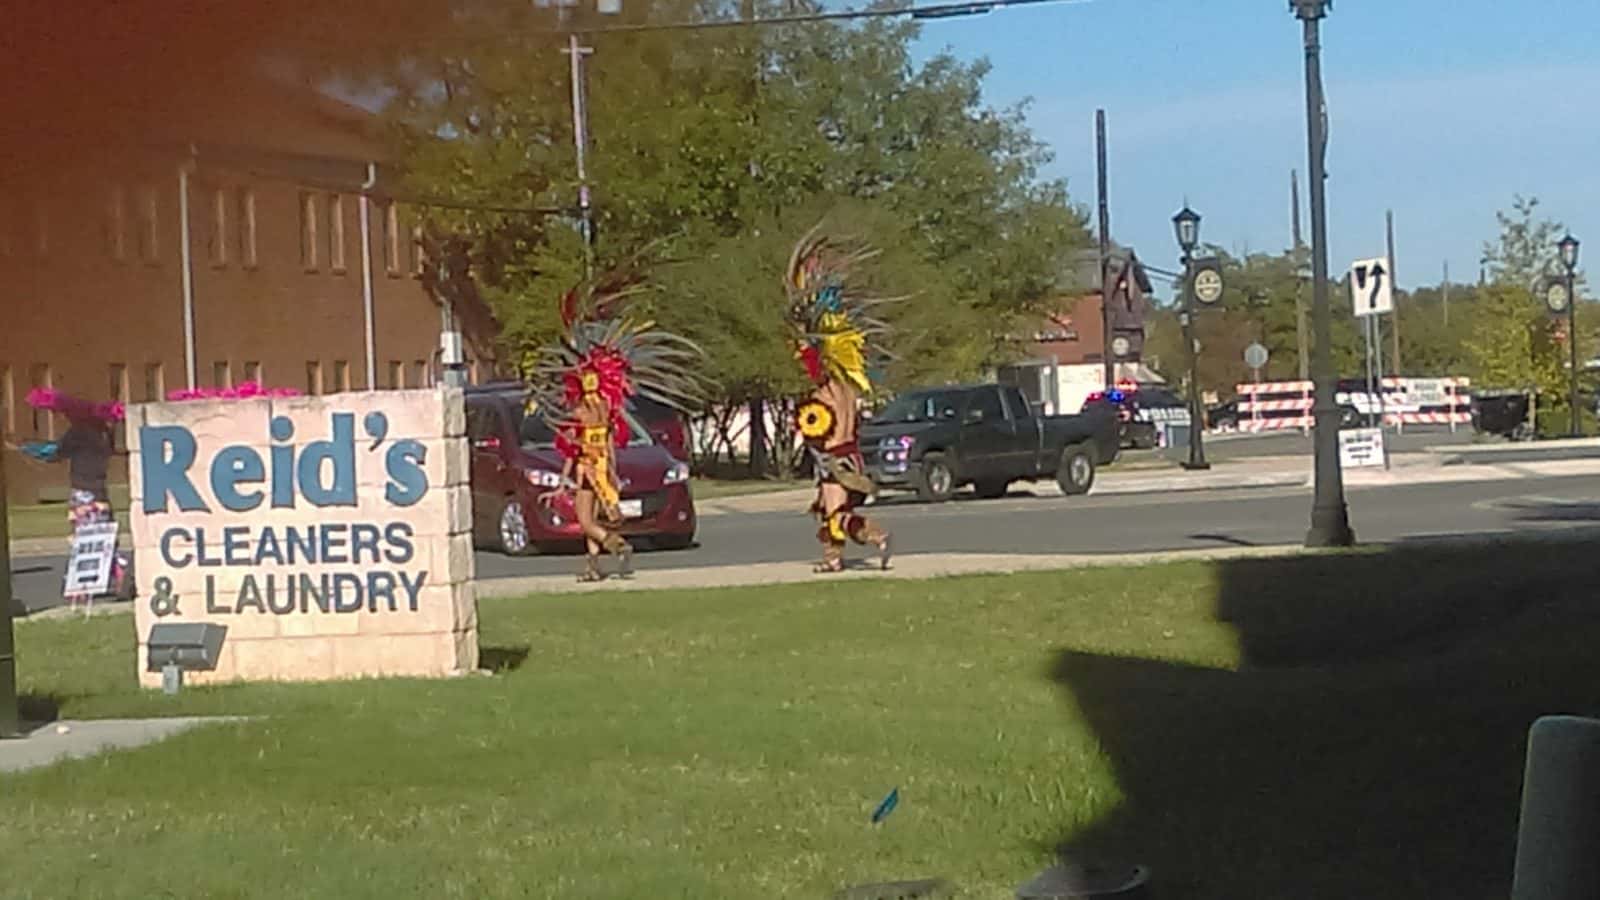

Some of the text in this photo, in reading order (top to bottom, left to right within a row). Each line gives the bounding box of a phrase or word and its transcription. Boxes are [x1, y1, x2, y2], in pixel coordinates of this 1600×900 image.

[139, 411, 429, 514] Reid's
[161, 521, 414, 568] CLEANERS
[150, 570, 428, 616] & LAUNDRY
